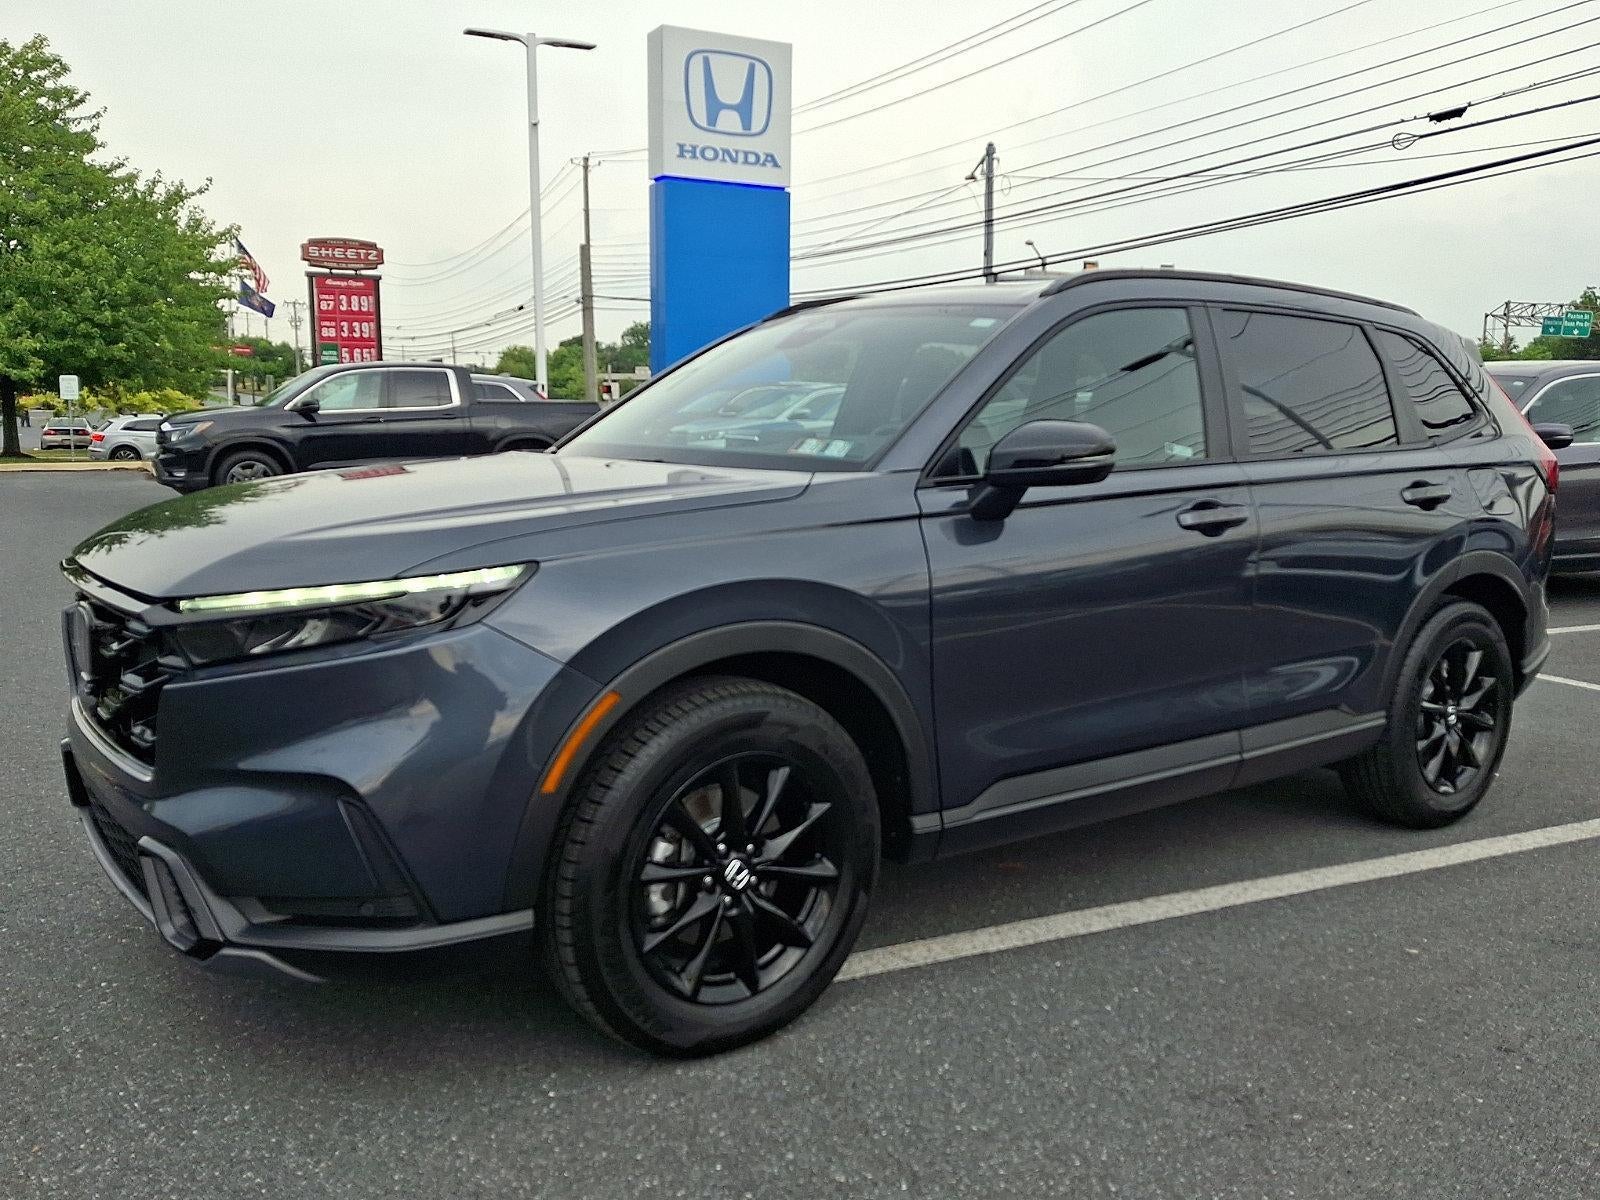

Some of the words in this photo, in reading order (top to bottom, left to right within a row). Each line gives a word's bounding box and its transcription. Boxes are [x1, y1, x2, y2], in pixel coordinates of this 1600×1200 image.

[676, 143, 781, 168] HONDA
[308, 246, 378, 260] SHEETZ
[320, 300, 334, 310] 87
